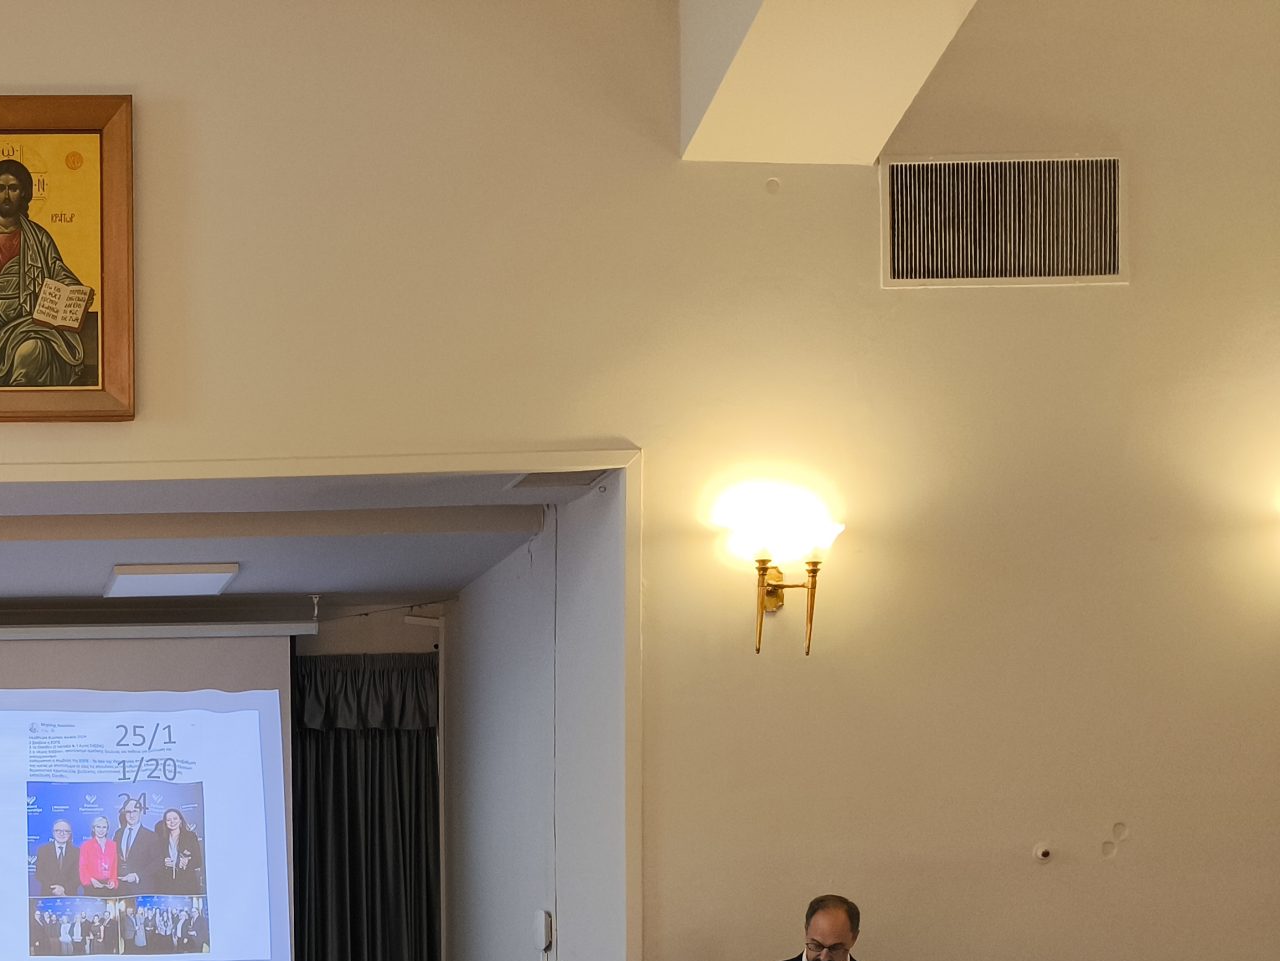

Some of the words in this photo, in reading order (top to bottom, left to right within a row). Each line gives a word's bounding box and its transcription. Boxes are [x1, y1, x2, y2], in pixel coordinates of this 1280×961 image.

[116, 722, 176, 751] 25/1
[117, 756, 177, 783] 1/20
[118, 792, 149, 816] 24
